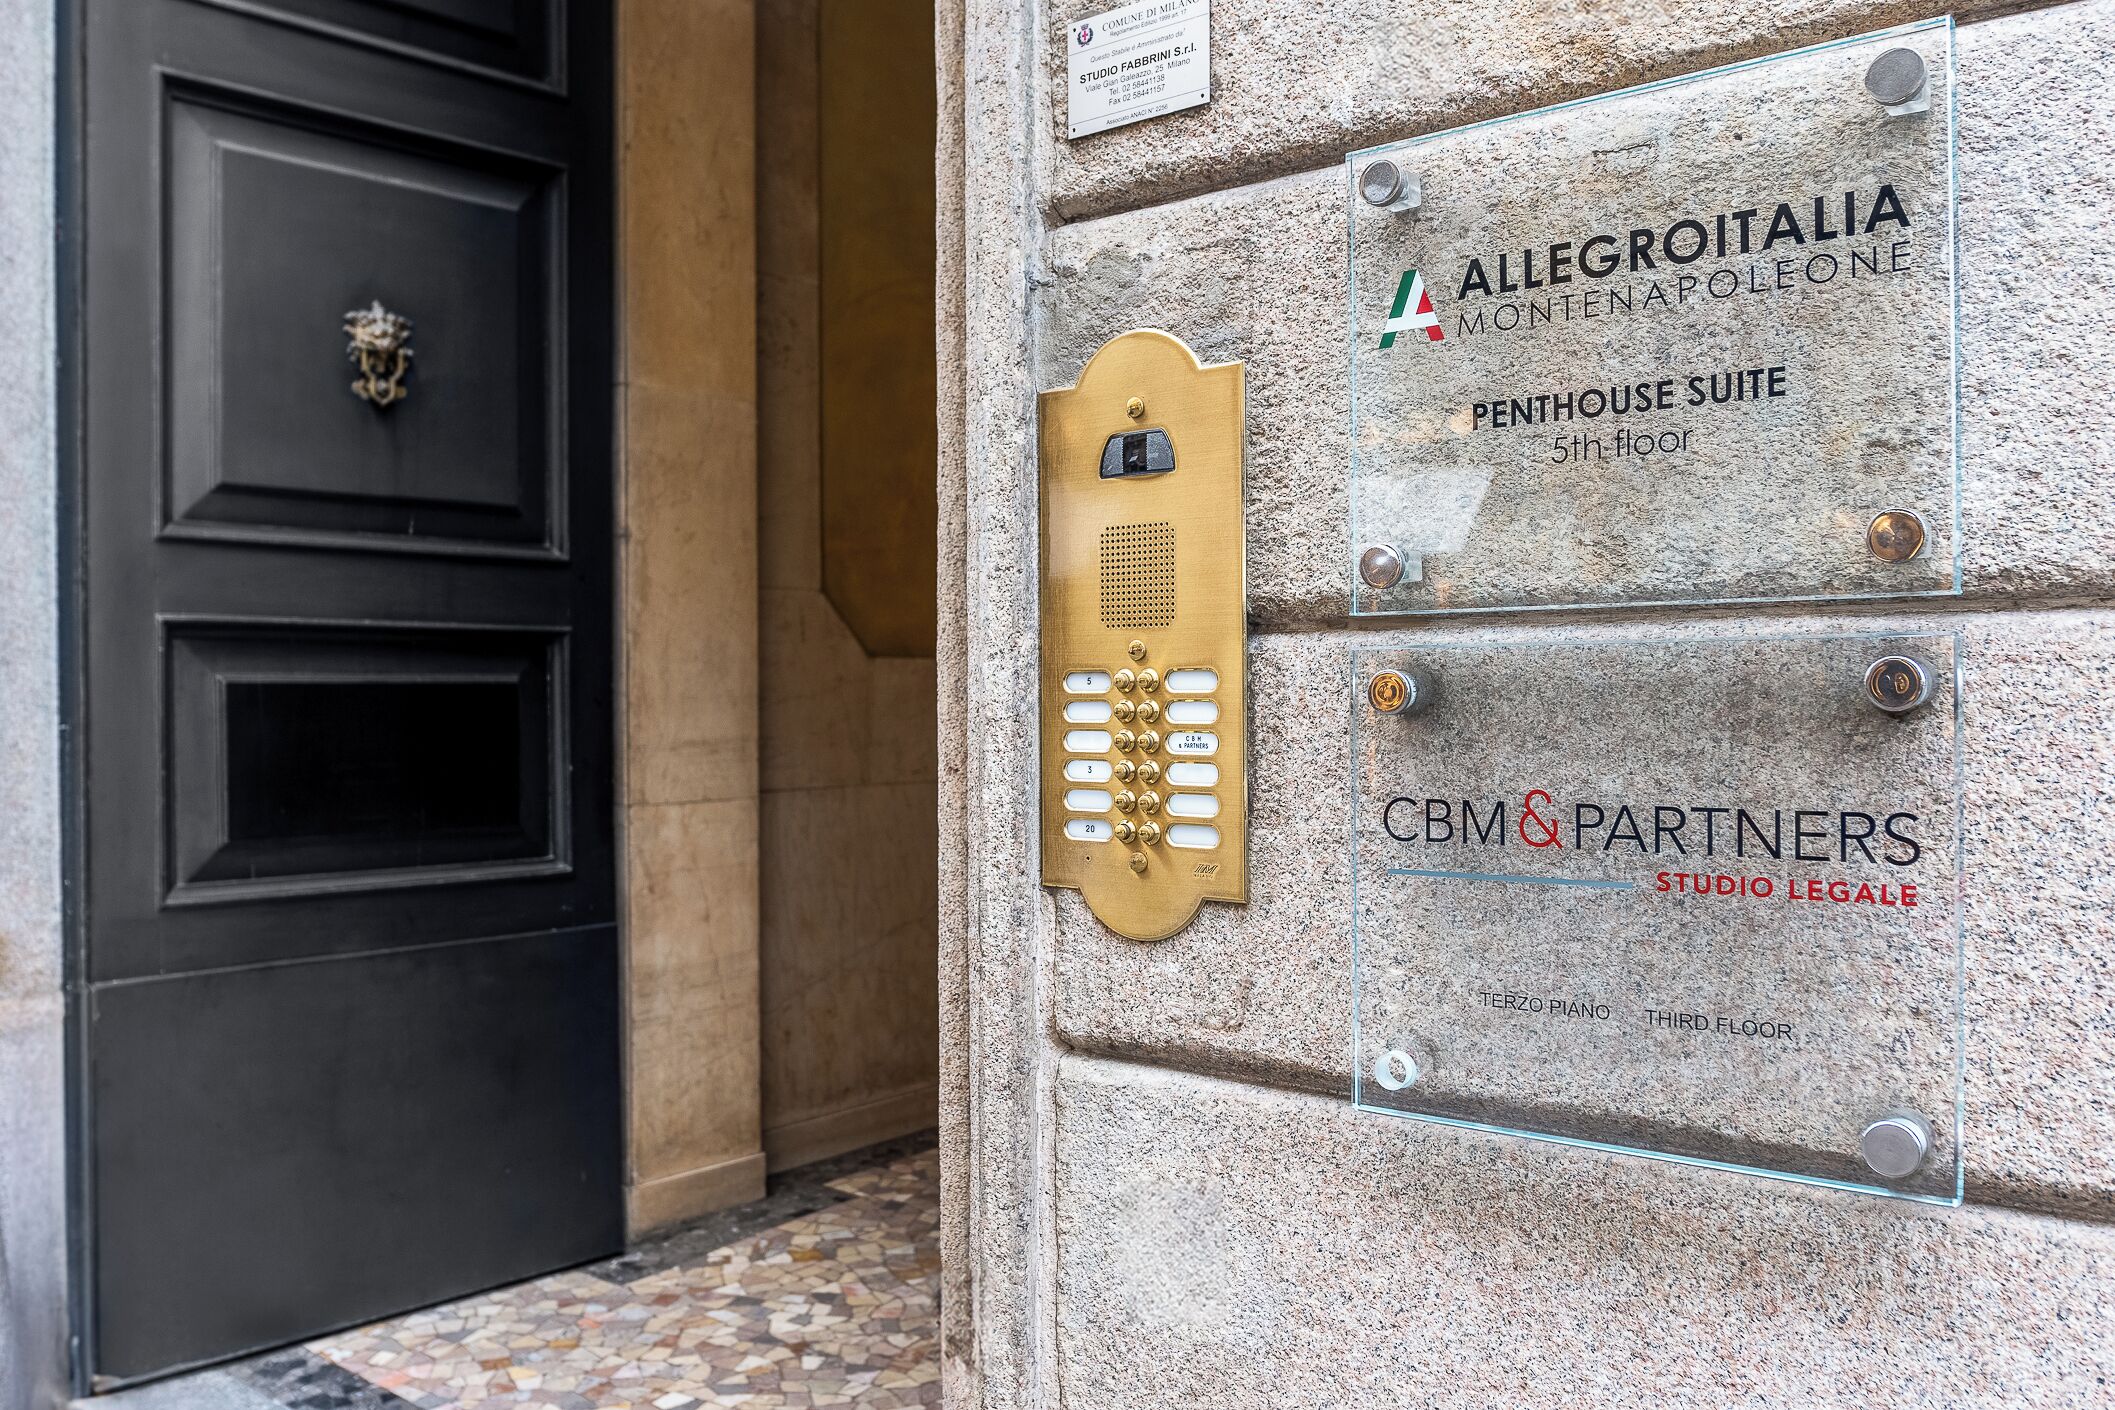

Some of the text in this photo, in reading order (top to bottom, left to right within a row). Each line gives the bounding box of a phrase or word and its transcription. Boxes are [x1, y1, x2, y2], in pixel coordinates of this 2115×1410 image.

[1102, 10, 1144, 32] COMUNE
[1146, 7, 1157, 18] DI
[1080, 42, 1197, 84] STUDIO FABBRINI S.r.l.
[1090, 52, 1110, 63] Questo
[1111, 46, 1130, 57] Stabile
[1136, 33, 1175, 49] Amministrato
[1085, 81, 1102, 93] Viale
[1103, 77, 1119, 89] Gian
[1155, 64, 1164, 73] 25
[1167, 57, 1191, 70] Milano
[1109, 73, 1165, 96] Tel. 02 58441138
[1108, 97, 1121, 106] Fax
[1122, 93, 1131, 102] 02
[1106, 114, 1130, 125] Associato
[1130, 108, 1147, 119] ANACI
[1457, 183, 1912, 301] ALLEGROITALIA
[1457, 240, 1912, 338] MONTENAPOLEONE
[1471, 365, 1787, 431] PENTHOUSE SUITE
[1551, 427, 1695, 464] 5th floor
[1086, 677, 1092, 686] 5
[1183, 742, 1209, 750] PARTNERS
[1087, 765, 1093, 774] 3
[1085, 824, 1095, 833] 20
[1656, 871, 1919, 907] STUDIO LEGALE
[1479, 991, 1611, 1021] TERZO PIANO
[1646, 1009, 1793, 1041] THIRD FLOOR
